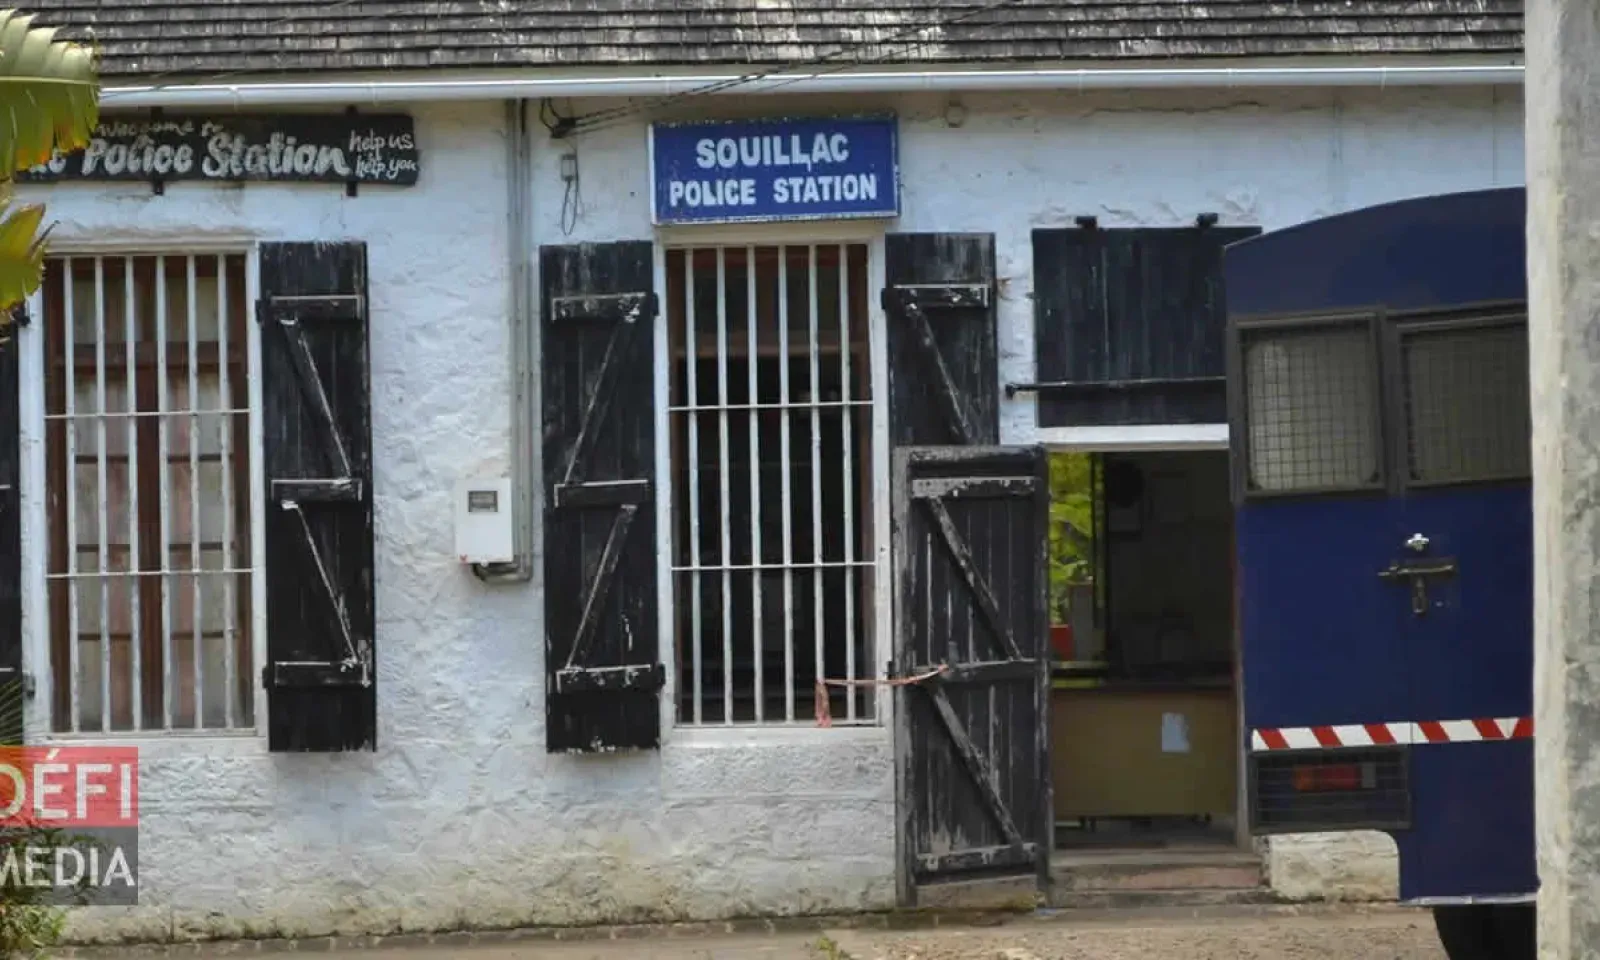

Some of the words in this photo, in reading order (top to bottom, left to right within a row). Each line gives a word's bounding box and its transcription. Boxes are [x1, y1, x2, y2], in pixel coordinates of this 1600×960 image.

[81, 137, 193, 176] Police
[201, 131, 351, 177] Station
[349, 127, 386, 161] help
[388, 132, 414, 150] us
[696, 133, 849, 169] SOUILLAC
[355, 152, 387, 179] help
[386, 157, 417, 180] you
[669, 178, 756, 207] POLICE
[773, 173, 877, 204] STATION
